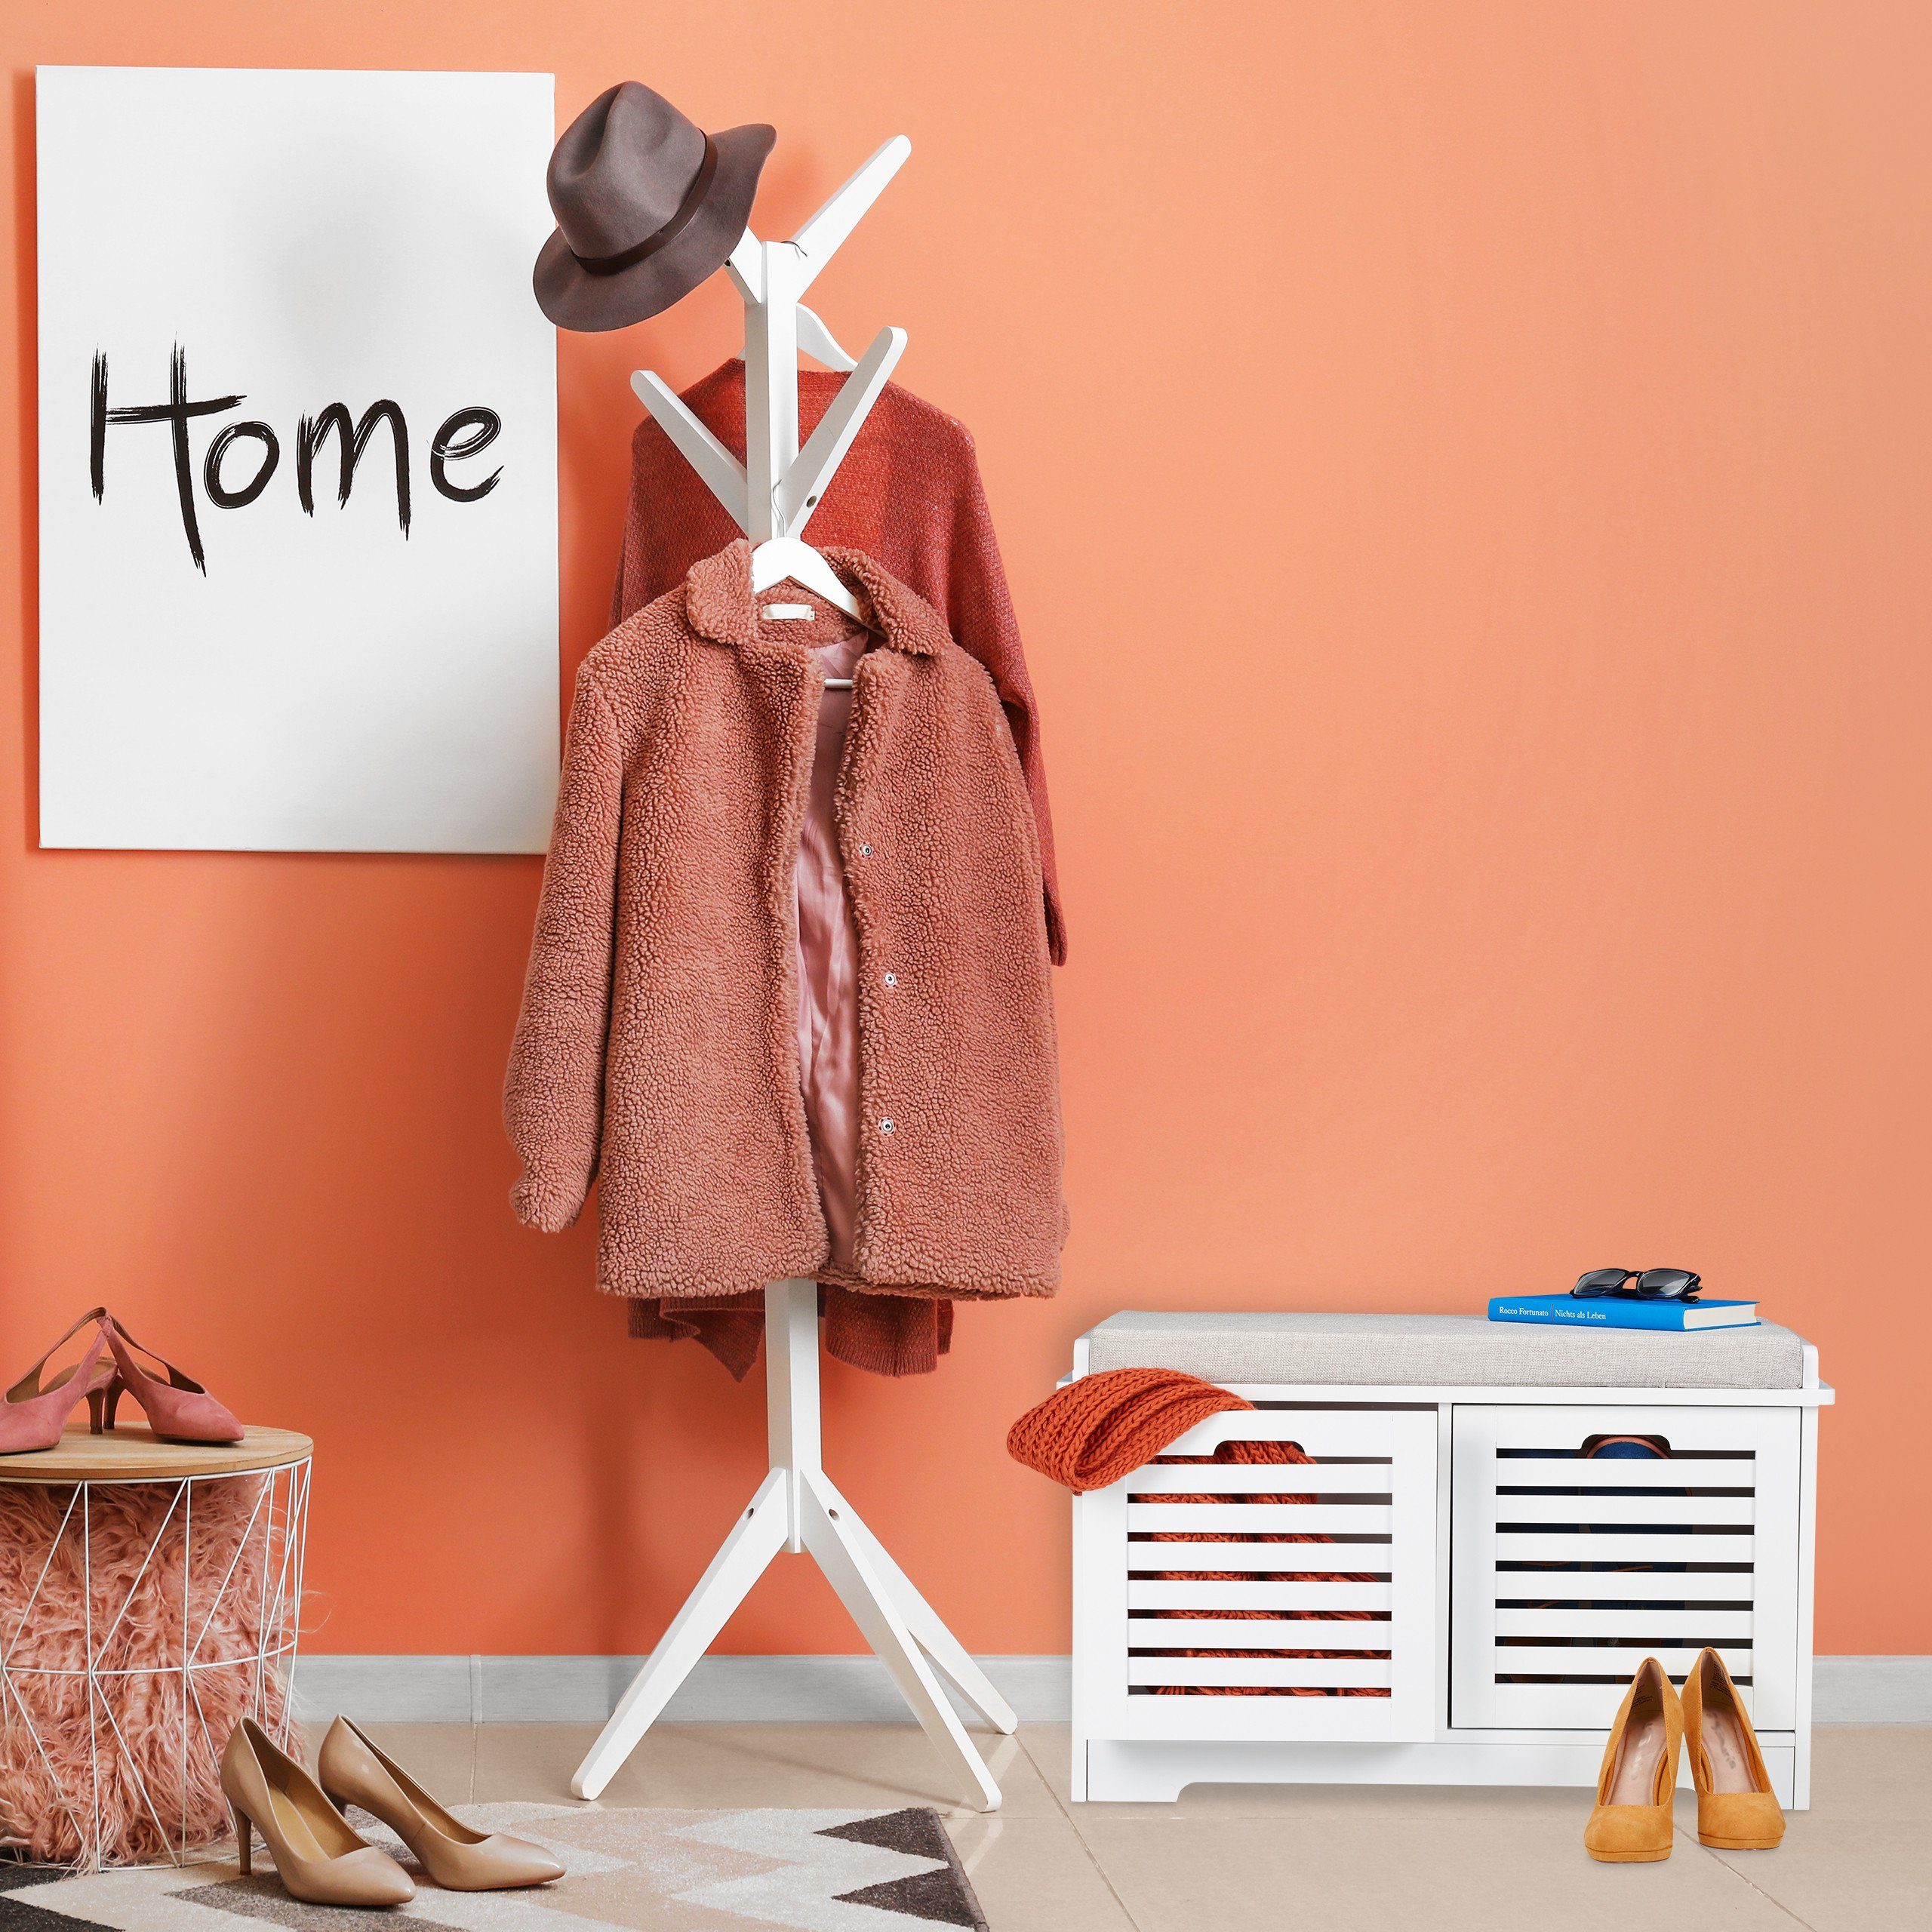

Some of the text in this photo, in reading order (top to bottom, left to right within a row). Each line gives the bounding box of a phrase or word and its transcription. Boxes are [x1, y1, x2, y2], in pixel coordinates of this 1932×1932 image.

[90, 332, 504, 577] Home
[1499, 1306, 1549, 1316] Rocco Fortunato
[1555, 1309, 1576, 1318] Nichts
[1586, 1311, 1606, 1320] Leben
